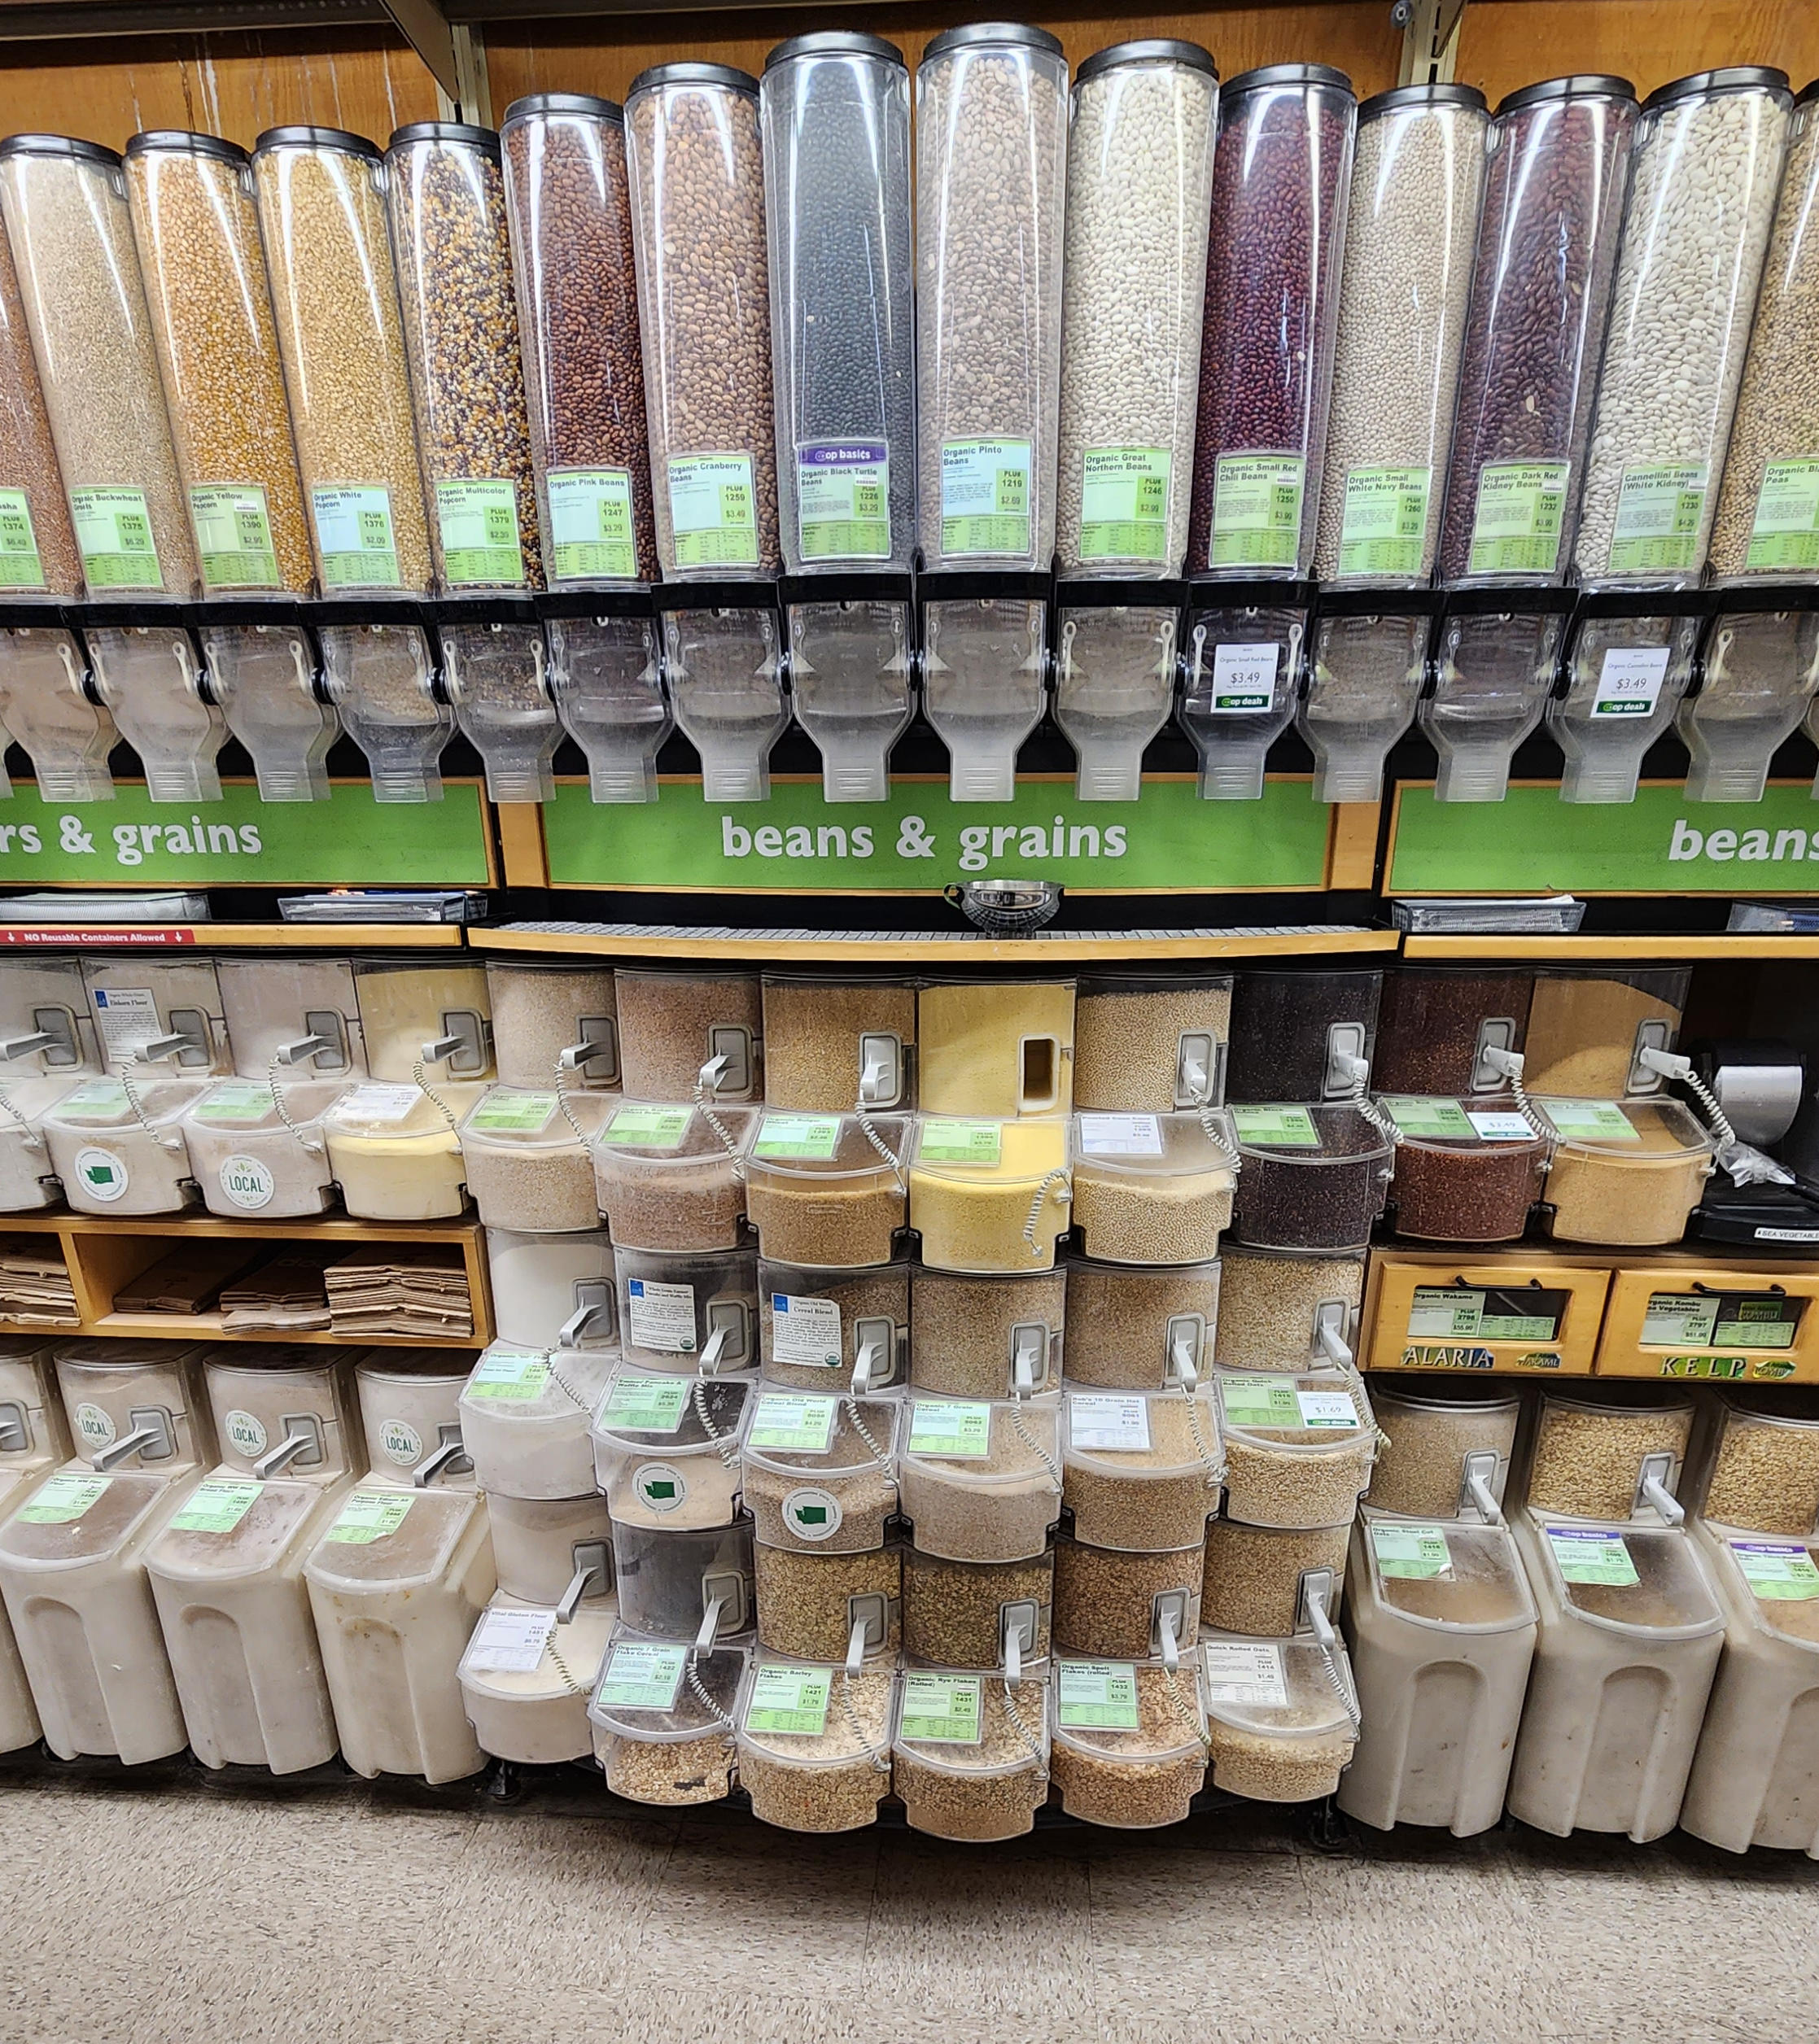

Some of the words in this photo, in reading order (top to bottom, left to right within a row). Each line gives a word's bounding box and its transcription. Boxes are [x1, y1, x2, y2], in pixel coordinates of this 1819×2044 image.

[839, 449, 871, 459] basics
[944, 447, 976, 457] Organic
[979, 446, 1002, 454] Pinto
[944, 457, 969, 465] Beans
[1087, 454, 1118, 464] Organic
[669, 465, 697, 474] Organic
[700, 462, 741, 471] Cranberry
[1087, 464, 1122, 472] Northern
[1221, 465, 1253, 474] Organic
[1283, 464, 1297, 472] Red
[1768, 466, 1805, 476] Organic
[801, 469, 828, 478] Organic
[1220, 474, 1238, 482] Chili
[1484, 473, 1518, 483] Organic
[1625, 472, 1671, 482] Cannellini
[671, 474, 692, 483] Beans
[802, 478, 822, 487] Beans
[1002, 479, 1022, 487] 1219
[1349, 475, 1382, 484] Organic
[550, 480, 576, 489] Organic
[1375, 483, 1397, 491] Navy
[1483, 482, 1514, 490] Kidney
[1624, 482, 1653, 492] (White
[1656, 479, 1689, 489] Kidney)
[439, 488, 463, 496] Organic
[1143, 487, 1161, 495] 1246
[72, 495, 94, 504] Organic
[191, 493, 214, 502] Organic
[314, 493, 337, 501] Organic
[1001, 496, 1020, 504] $2.69
[316, 501, 340, 509] Popcorn
[859, 504, 878, 512] $3.29
[1231, 672, 1260, 684] $3.49
[1616, 679, 1646, 689] $3.49
[59, 815, 96, 854] &
[112, 815, 263, 866] grains
[721, 815, 874, 858] beans
[896, 815, 936, 858] &
[959, 815, 1127, 871] grains
[24, 933, 40, 941] NO
[42, 933, 80, 941] Reusable
[81, 933, 128, 941] Containers
[130, 933, 165, 941] Allowed
[229, 1175, 265, 1192] LOCAL
[1414, 1292, 1441, 1300] Organic
[1404, 1347, 1493, 1368] ALARIA
[1660, 1357, 1746, 1376] KELP
[81, 1420, 109, 1436] LOCAL
[232, 1426, 260, 1443] LOCAL
[386, 1435, 414, 1452] LOCAL
